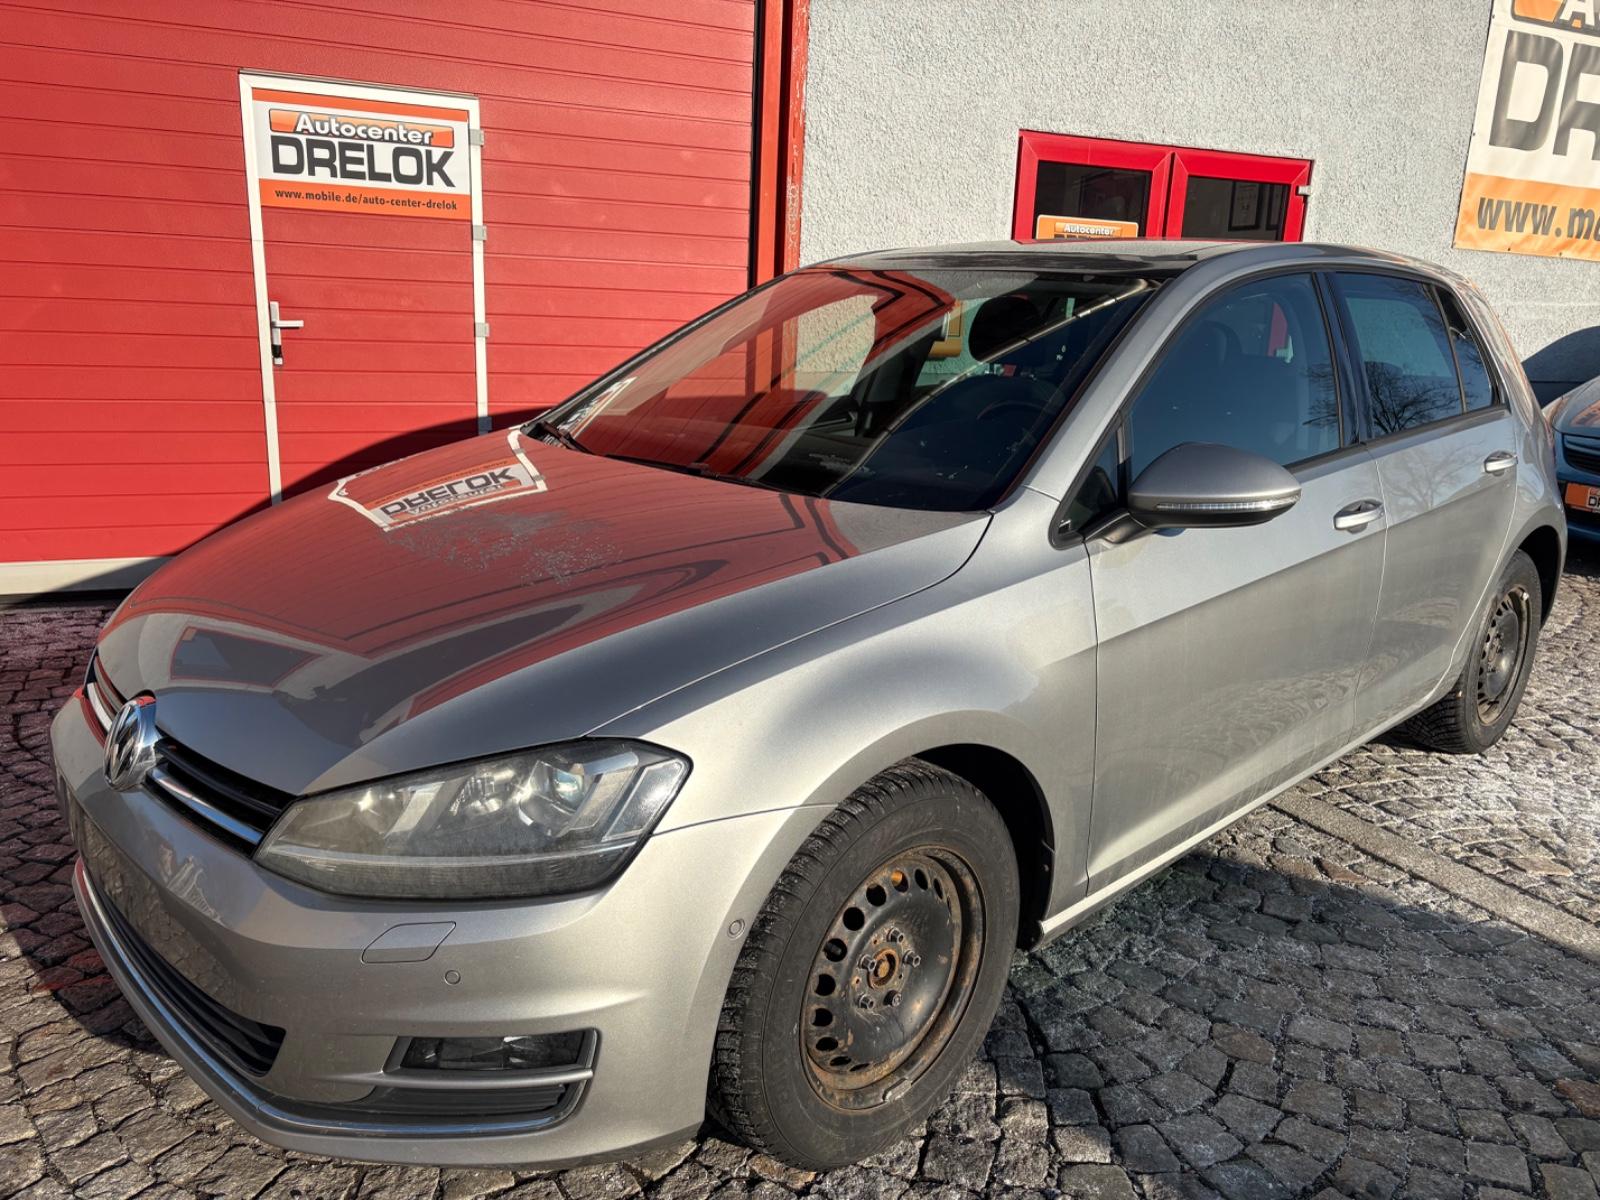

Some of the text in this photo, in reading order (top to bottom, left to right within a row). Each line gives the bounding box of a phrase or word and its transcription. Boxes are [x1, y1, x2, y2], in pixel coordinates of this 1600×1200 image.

[295, 113, 433, 145] Autocenter
[271, 135, 456, 187] DRELOK
[274, 188, 457, 210] www.mobile.de/auto-center-drelok
[1064, 223, 1114, 235] Autocenter
